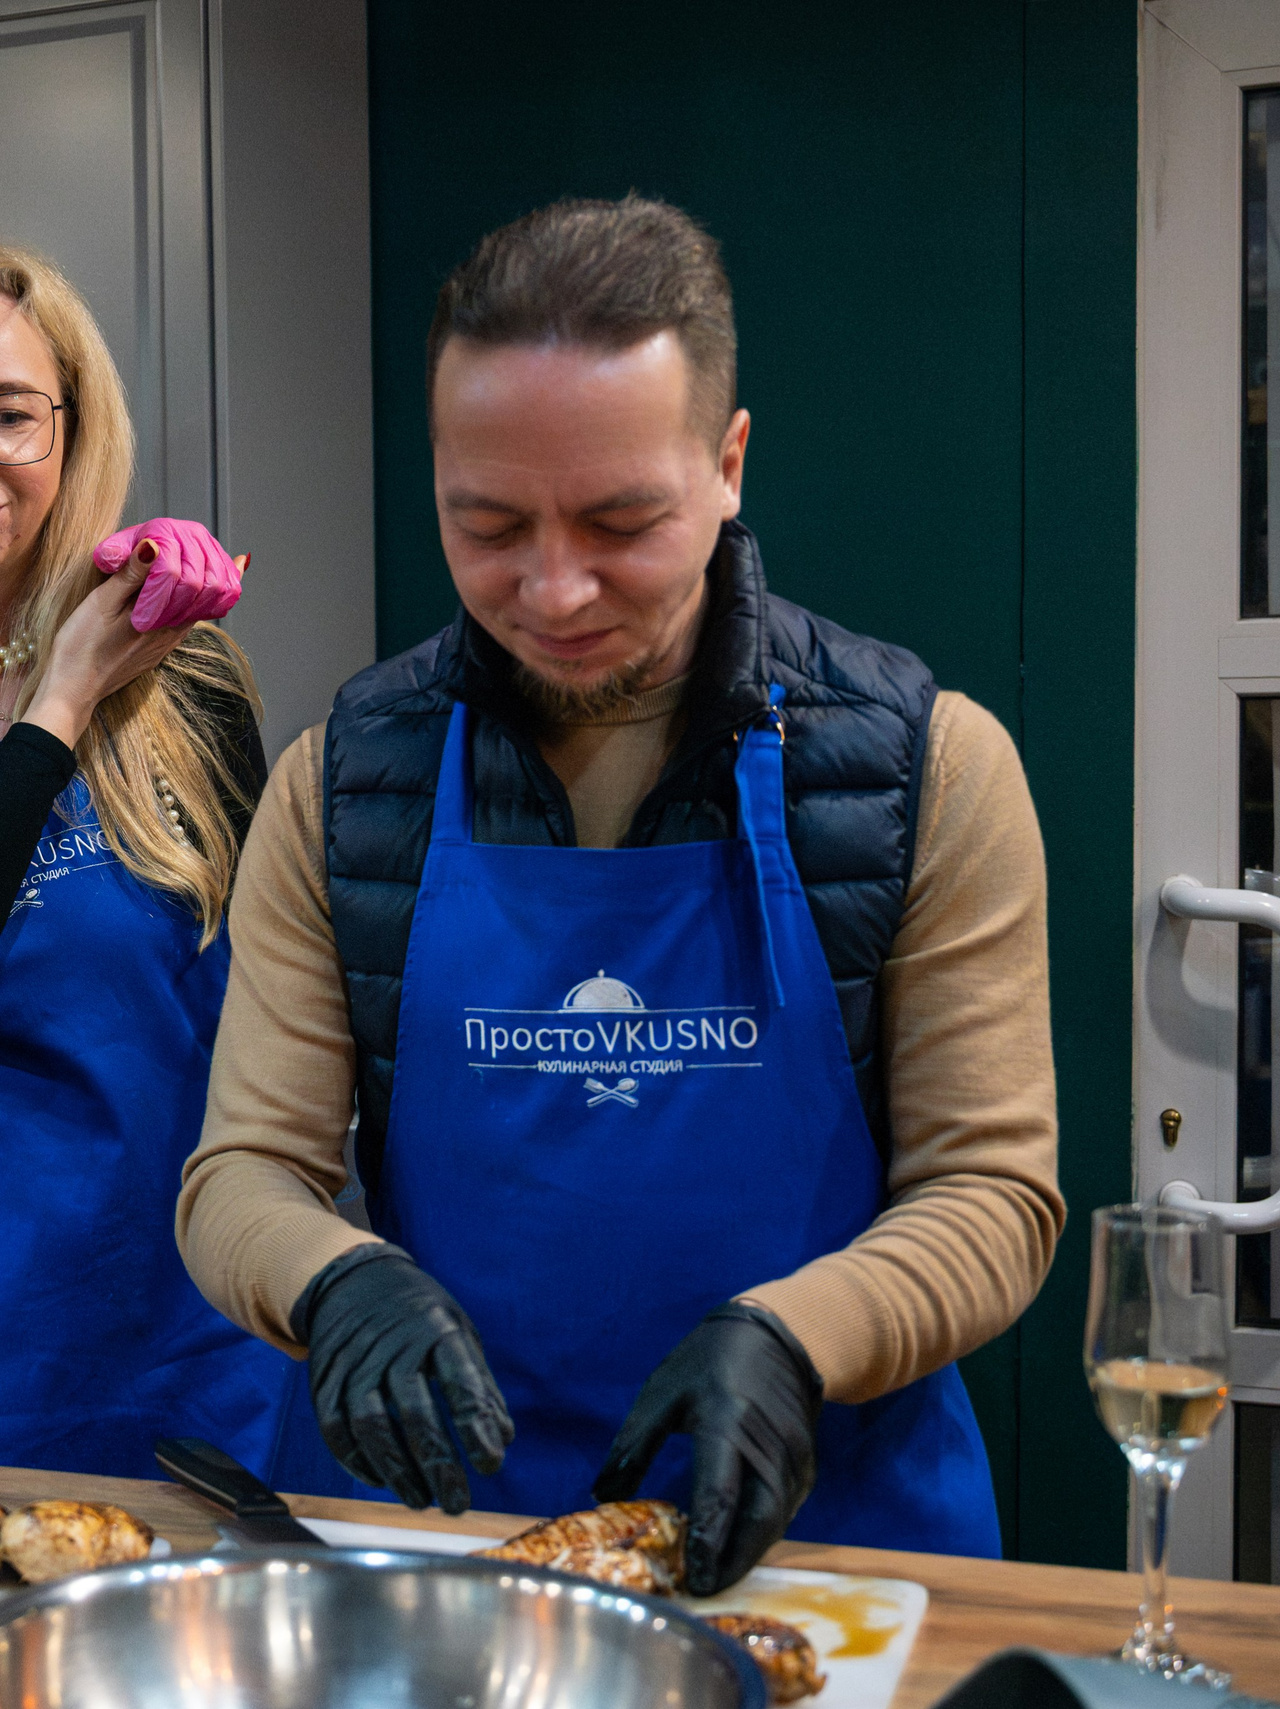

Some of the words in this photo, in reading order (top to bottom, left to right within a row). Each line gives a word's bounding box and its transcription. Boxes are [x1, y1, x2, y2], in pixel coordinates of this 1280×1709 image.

[31, 866, 70, 885] СТУДИЯ
[465, 1017, 758, 1058] ПростоVKUSNO
[538, 1060, 627, 1074] КУЛИНАРНАЯ
[630, 1060, 683, 1075] СТУДИЯ
